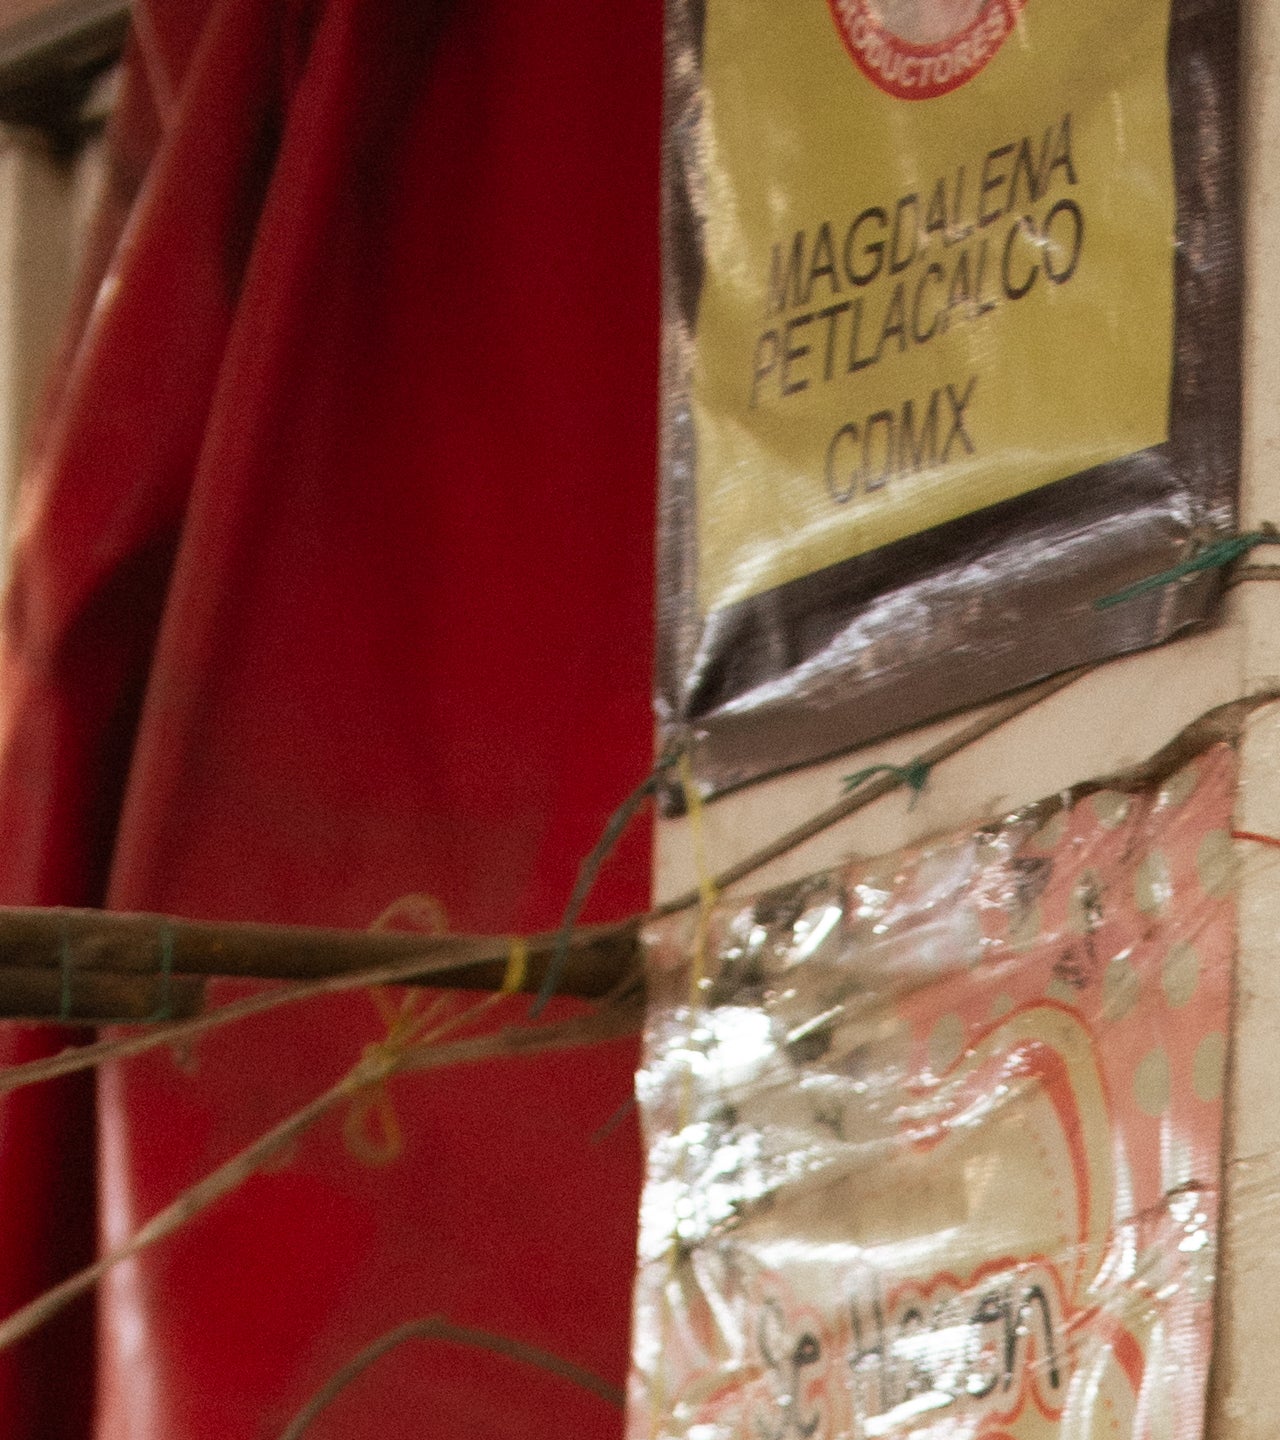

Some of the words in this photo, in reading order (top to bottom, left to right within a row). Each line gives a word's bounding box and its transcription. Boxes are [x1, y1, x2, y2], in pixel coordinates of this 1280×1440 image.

[750, 198, 1084, 408] PETLACALCO
[765, 113, 1079, 320] MAGDALENA
[824, 374, 978, 503] CDMX
